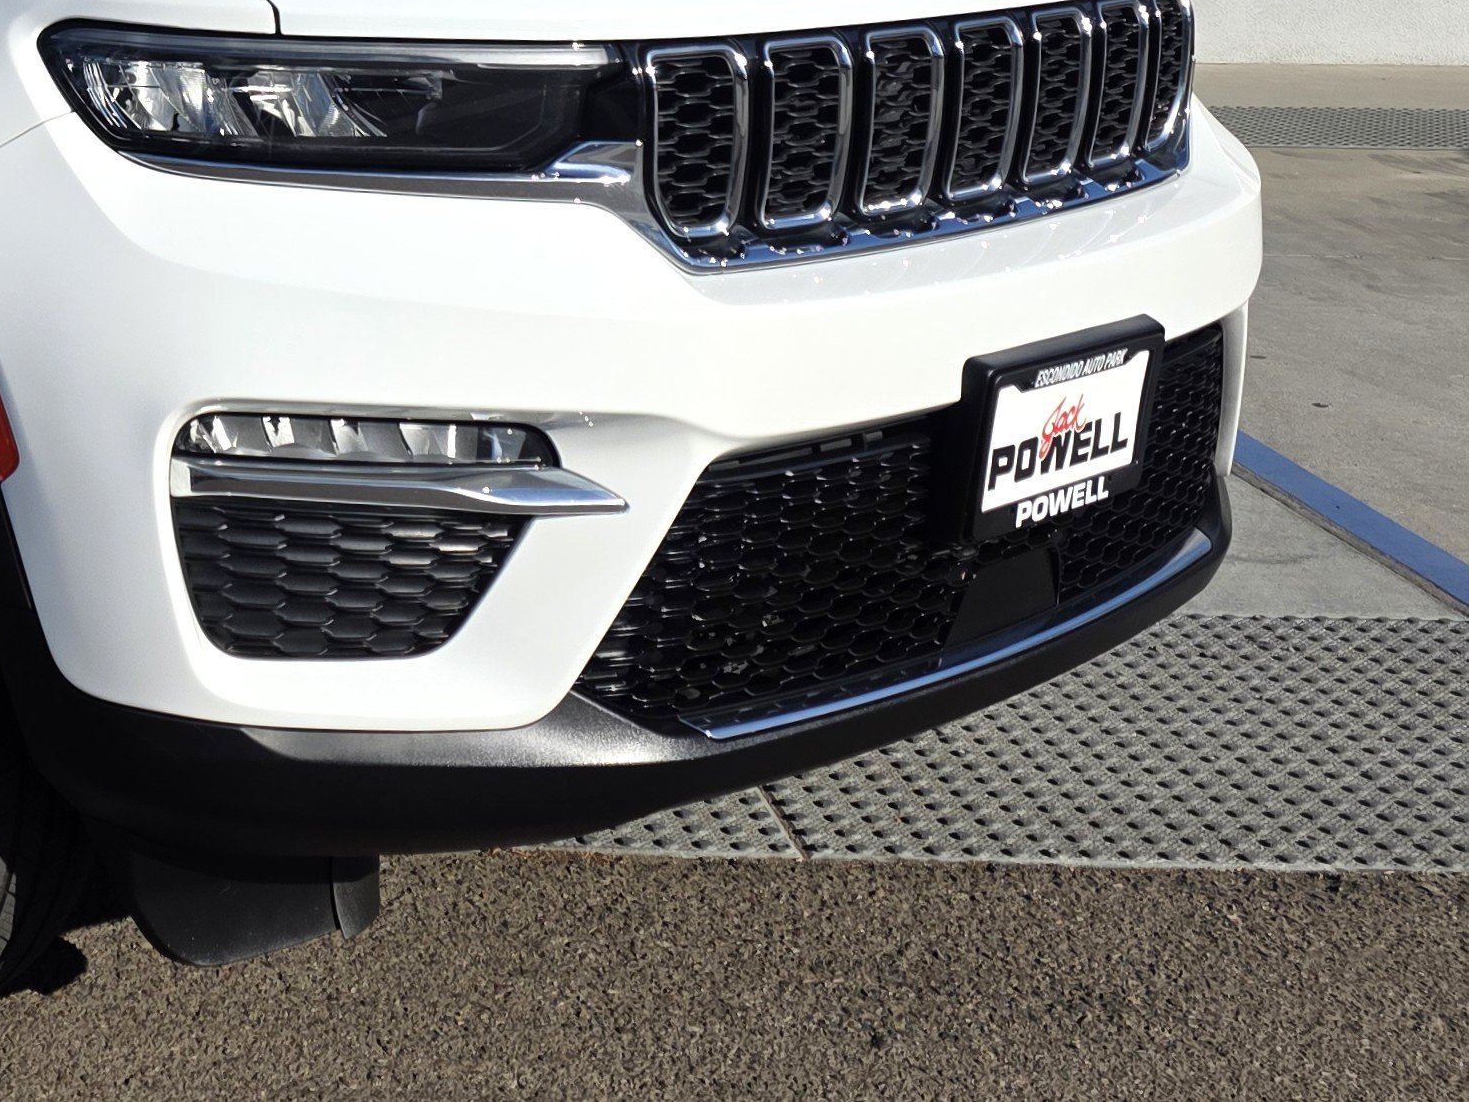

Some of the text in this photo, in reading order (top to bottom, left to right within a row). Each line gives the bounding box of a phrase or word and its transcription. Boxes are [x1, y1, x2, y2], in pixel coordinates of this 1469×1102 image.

[1034, 347, 1129, 388] ESCONDIDO AUTO PARK
[987, 411, 1129, 492] POWELL
[1038, 393, 1087, 460] Jack
[1014, 475, 1110, 529] POWELL
